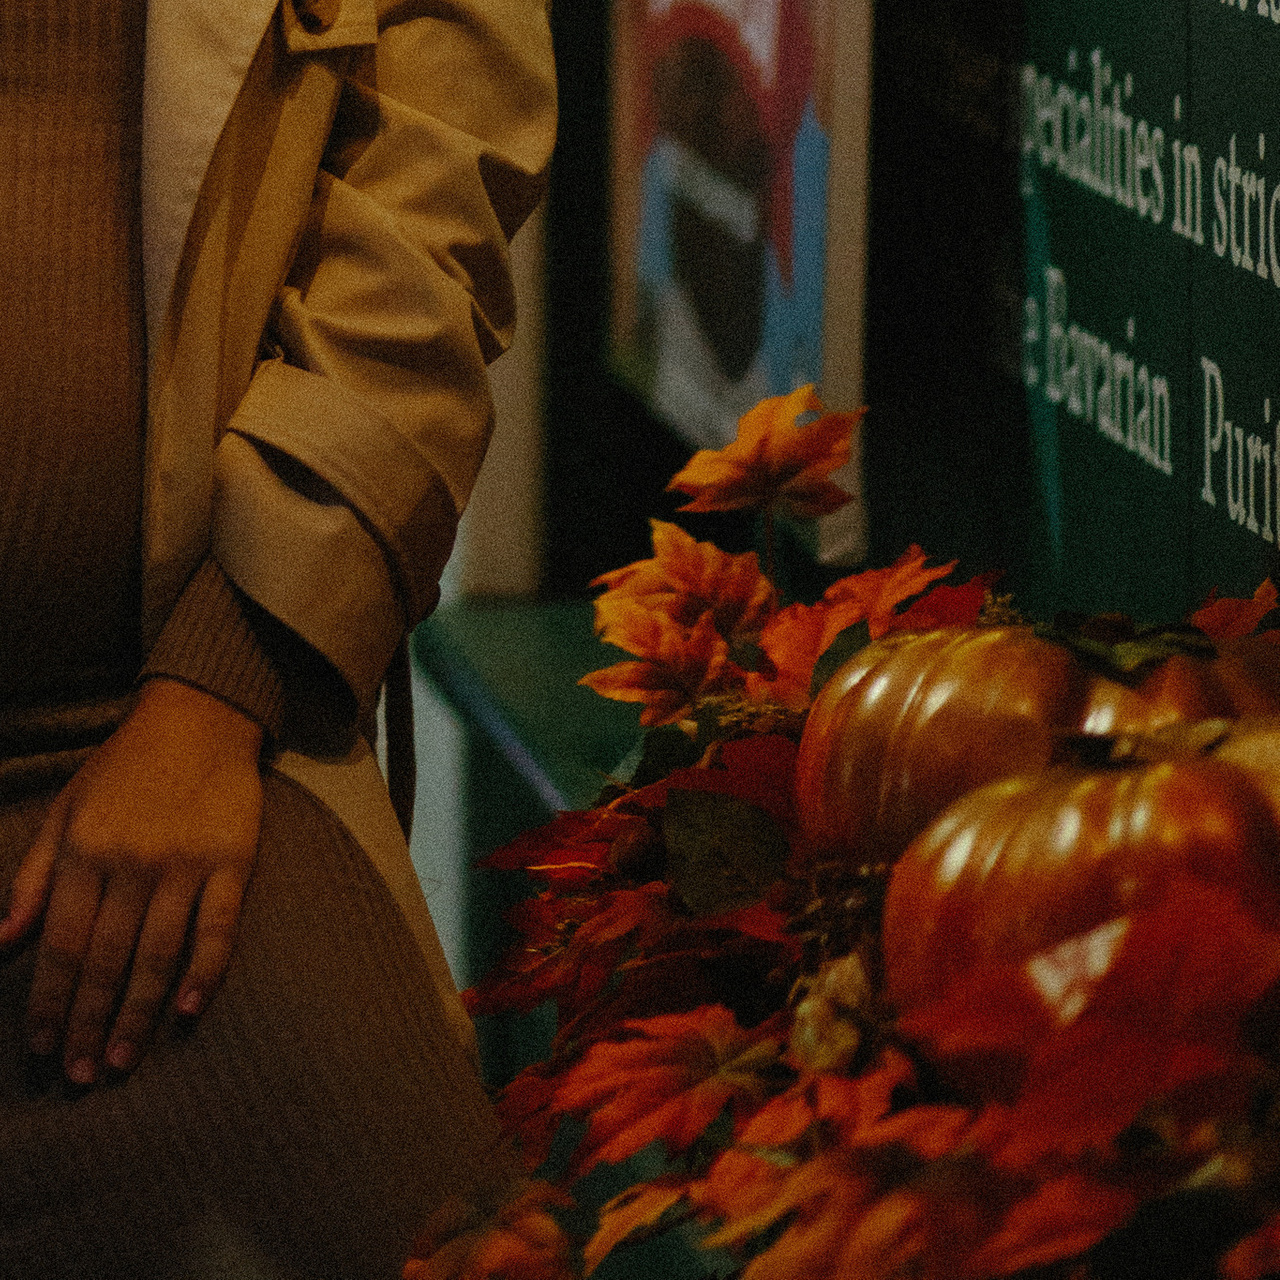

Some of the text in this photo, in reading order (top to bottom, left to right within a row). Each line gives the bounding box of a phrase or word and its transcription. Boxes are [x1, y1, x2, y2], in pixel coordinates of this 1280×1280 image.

[1020, 46, 1165, 225] pecialities
[1172, 94, 1205, 246] in
[1045, 265, 1172, 476] Bavarian
